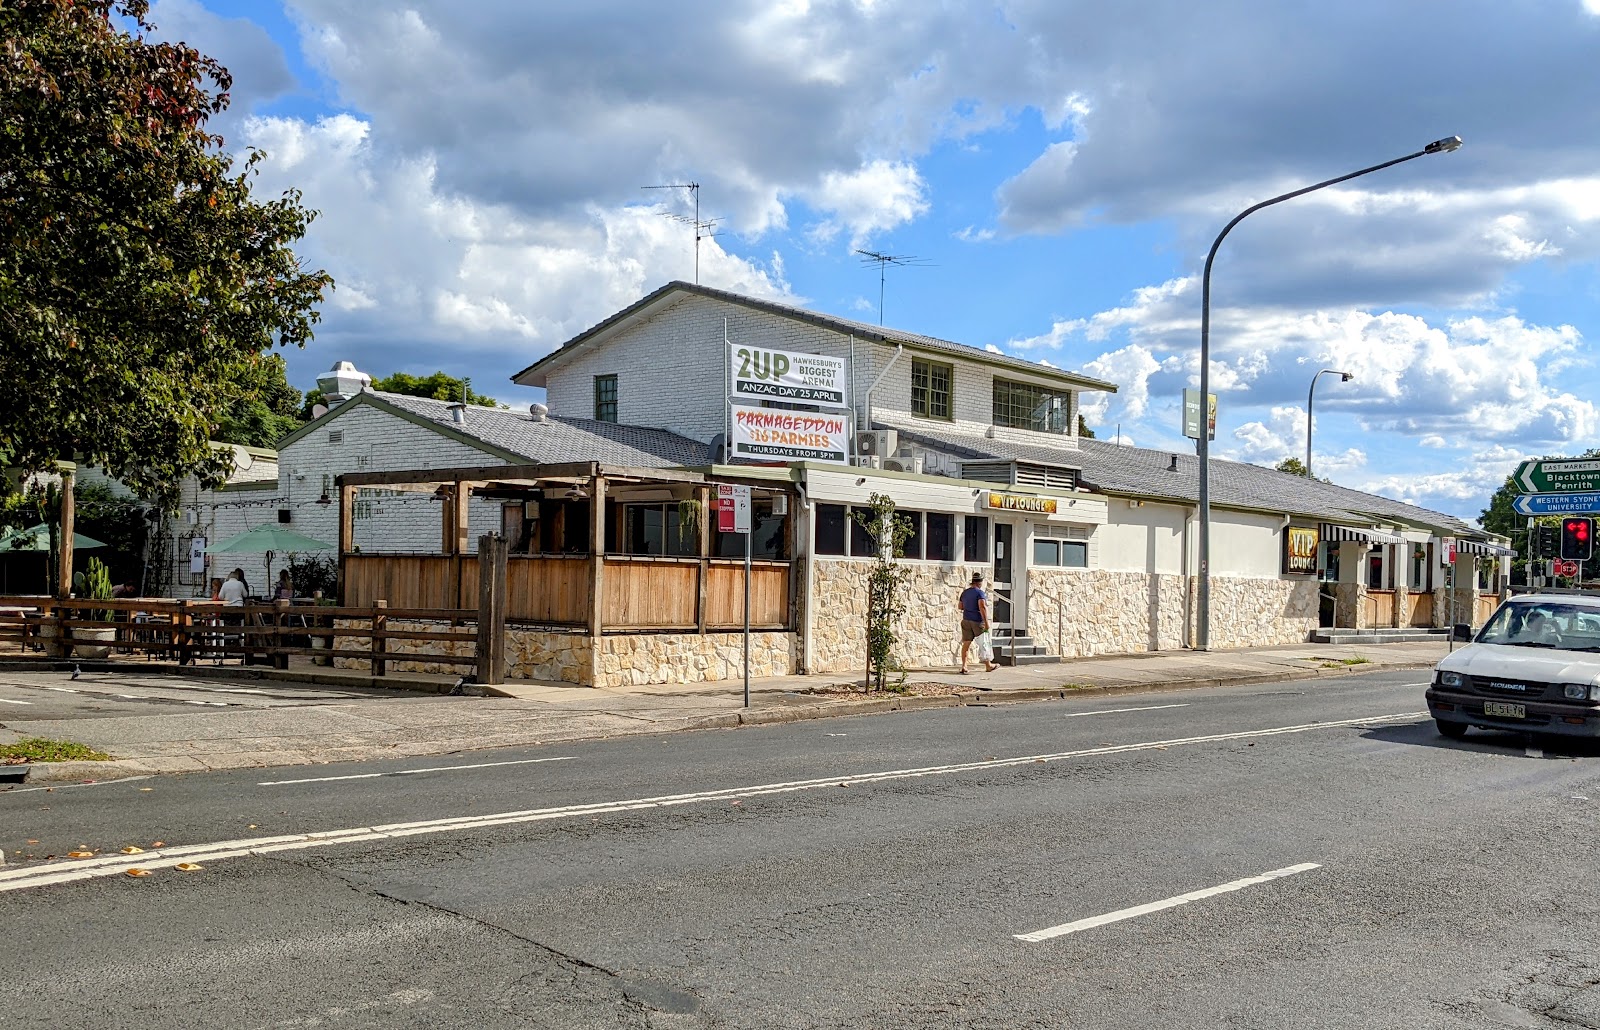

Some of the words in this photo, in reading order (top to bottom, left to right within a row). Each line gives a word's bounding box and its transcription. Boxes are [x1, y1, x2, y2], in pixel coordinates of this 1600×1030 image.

[737, 348, 790, 382] 2UP
[793, 356, 842, 369] HAWKESBURY'S
[799, 366, 837, 379] BIGGEST
[802, 376, 834, 388] ARENA!
[742, 382, 777, 394] ANZAC
[779, 386, 798, 397] DAY
[800, 389, 811, 398] 25
[813, 391, 838, 401] APRIL
[736, 410, 843, 435] PARMAGEDDON
[750, 429, 769, 443] $16
[771, 430, 830, 448] PARMIES
[747, 445, 793, 456] THURSDAYS
[796, 449, 817, 458] FROM
[820, 451, 835, 459] 5PM
[1546, 473, 1600, 482] Blacktown
[1554, 482, 1593, 490] Penrith
[1000, 494, 1015, 509] VIP
[1016, 498, 1046, 512] LOUNGE
[1573, 495, 1600, 503] SYDNE
[1547, 503, 1593, 511] UNIVERSITY
[1292, 534, 1314, 557] VIP
[1290, 556, 1316, 570] LOUNGE
